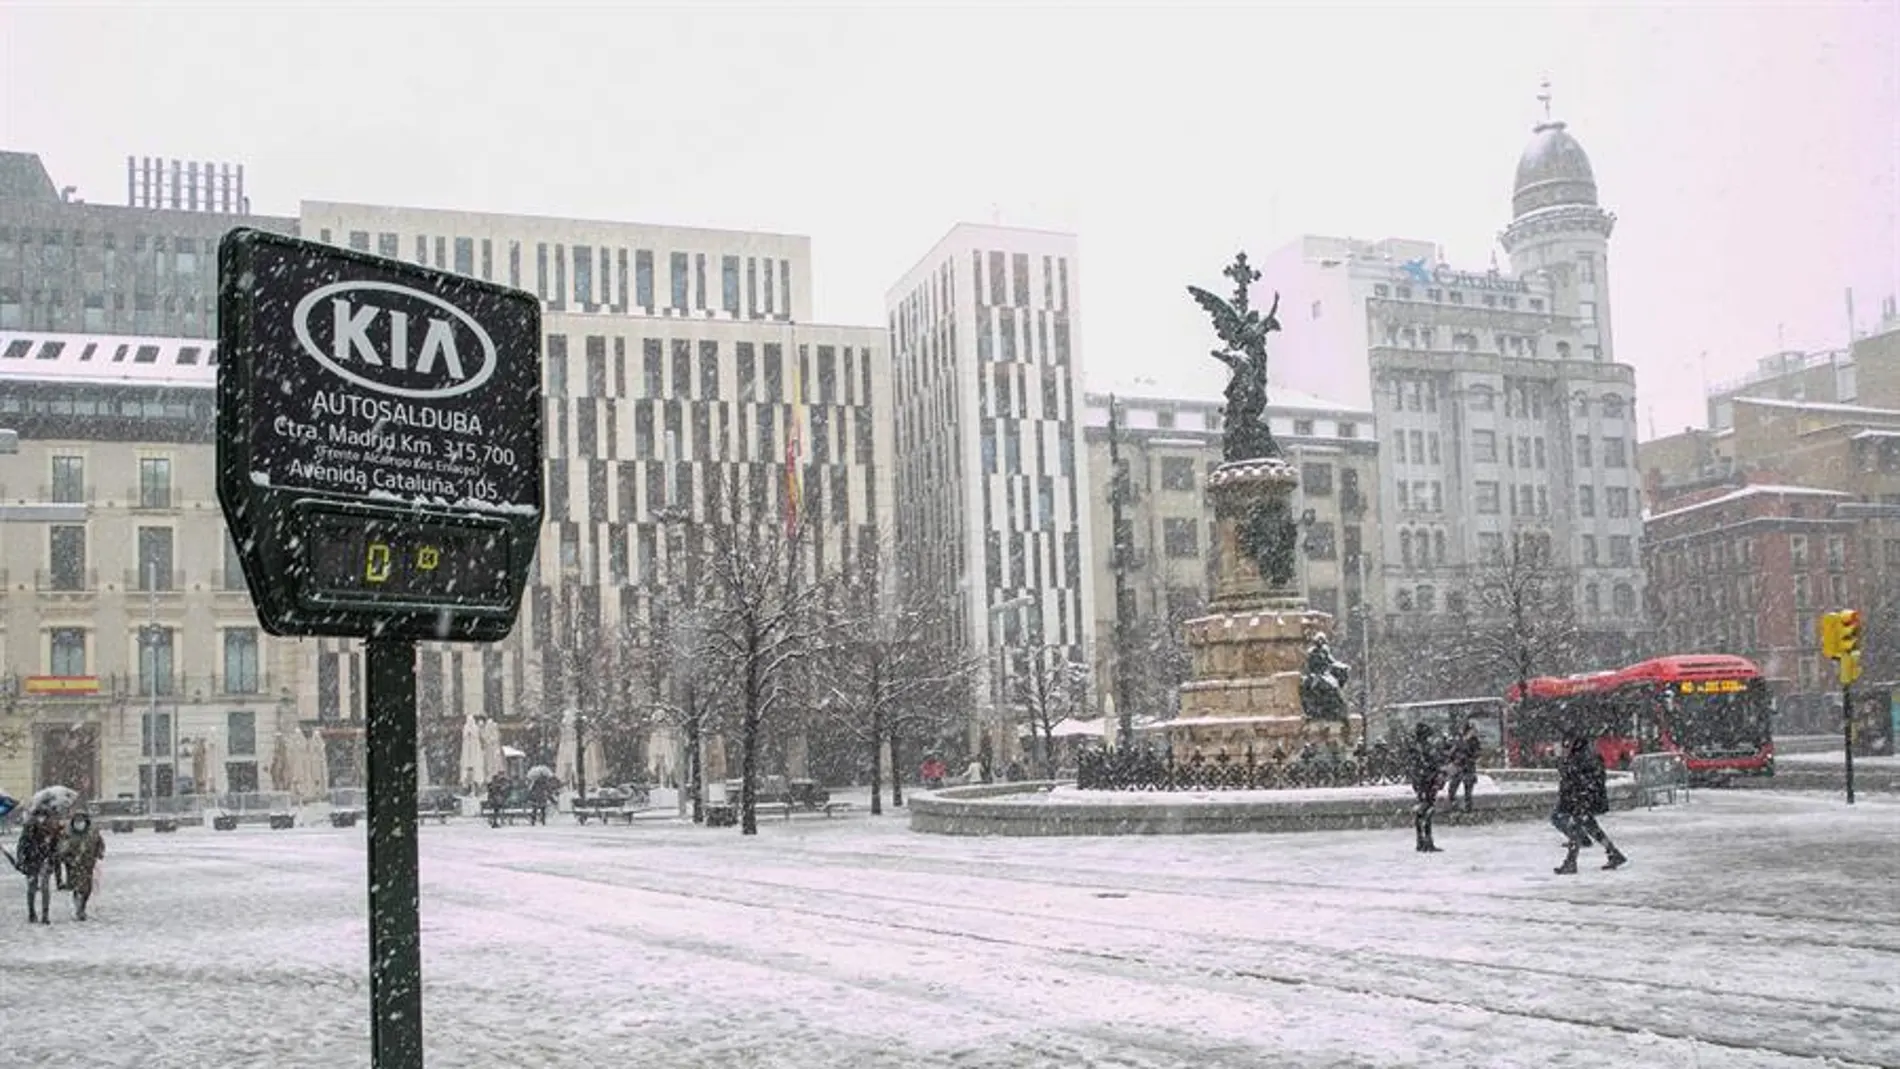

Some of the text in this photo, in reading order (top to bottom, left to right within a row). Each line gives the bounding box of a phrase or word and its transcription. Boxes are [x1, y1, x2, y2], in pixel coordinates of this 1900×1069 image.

[332, 299, 466, 381] KIA
[311, 389, 483, 437] AUTOSALDUBA
[328, 423, 396, 451] Madrid
[288, 458, 367, 485] Avenida
[372, 467, 459, 498] Cataluña,
